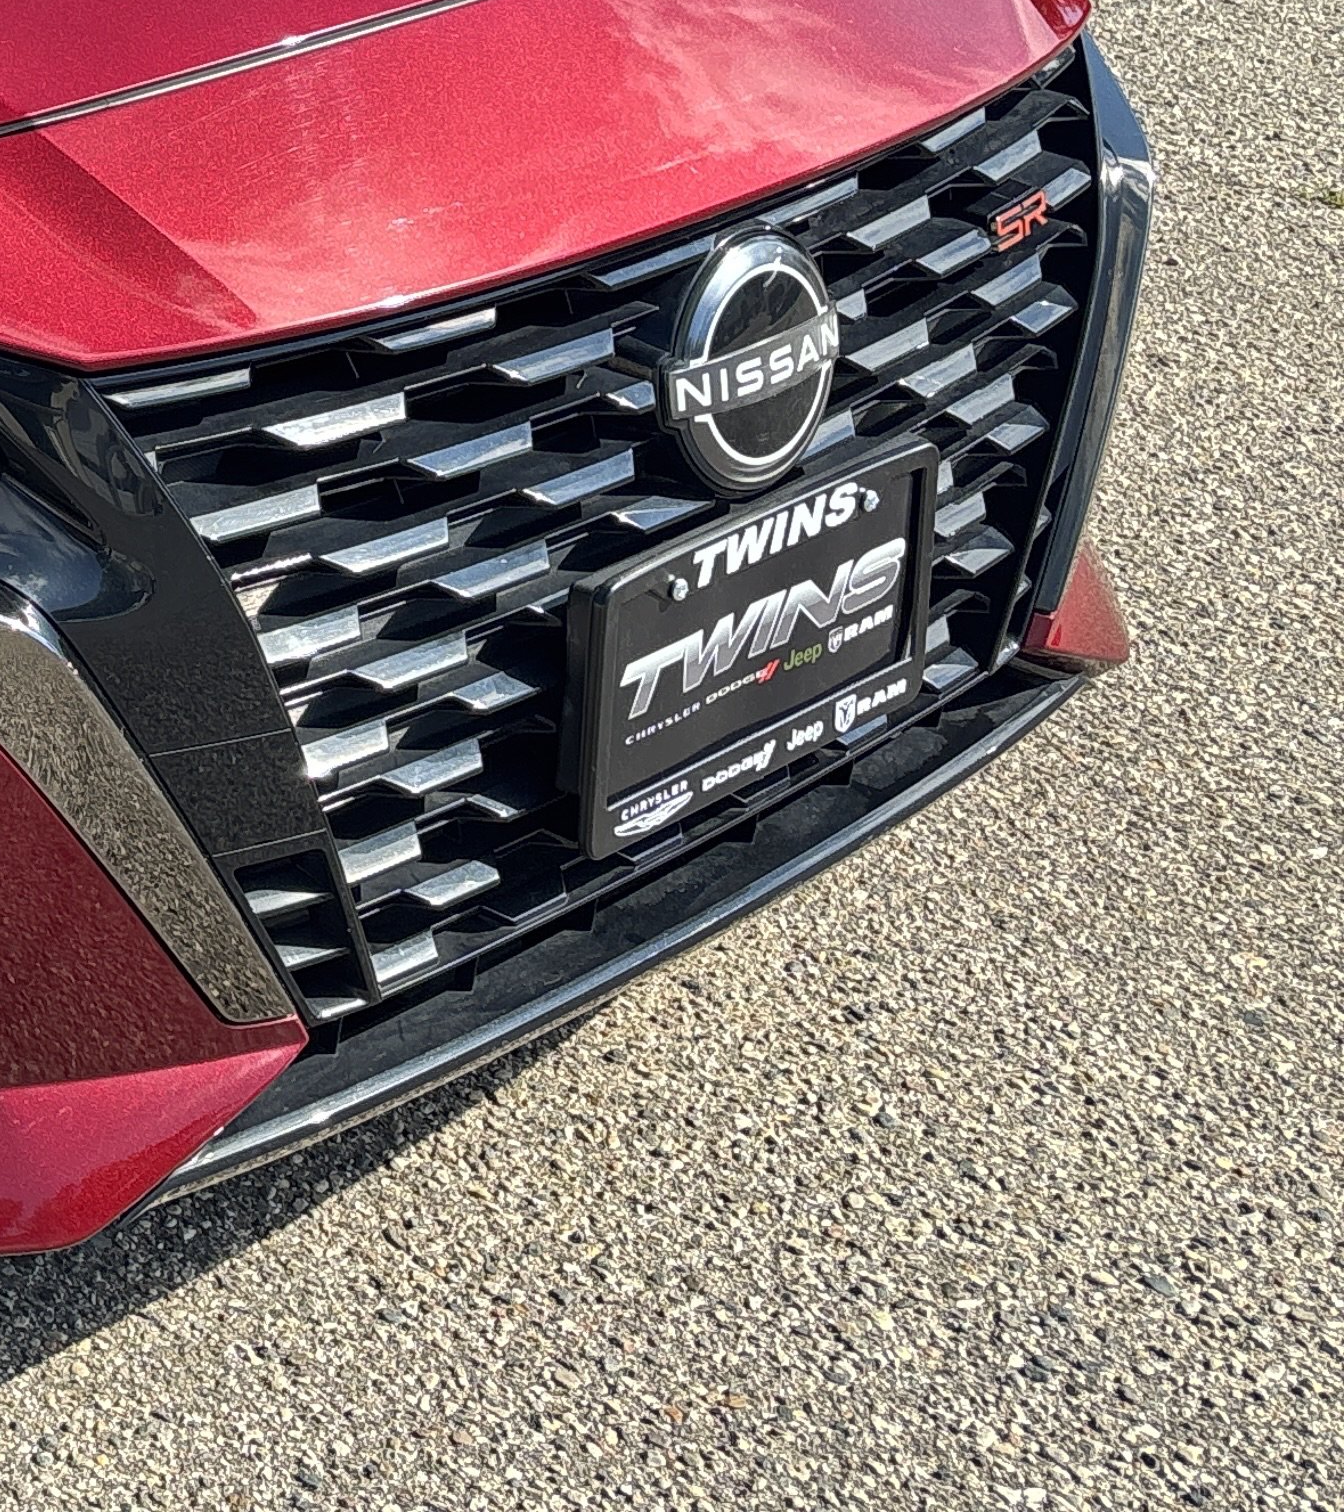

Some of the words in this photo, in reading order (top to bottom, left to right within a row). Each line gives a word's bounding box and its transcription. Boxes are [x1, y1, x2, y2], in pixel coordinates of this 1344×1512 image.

[996, 190, 1049, 253] SR
[675, 314, 839, 412] NISSAN
[693, 482, 859, 589] TWINS
[620, 538, 906, 720] TWINS
[625, 701, 702, 746] CHRYSLER
[705, 668, 771, 705] DODGE
[783, 643, 823, 671] Jeep
[844, 604, 894, 642] RAM
[620, 780, 688, 821] CHRYSLER
[786, 720, 824, 751] Jeep
[856, 678, 908, 716] RAM
